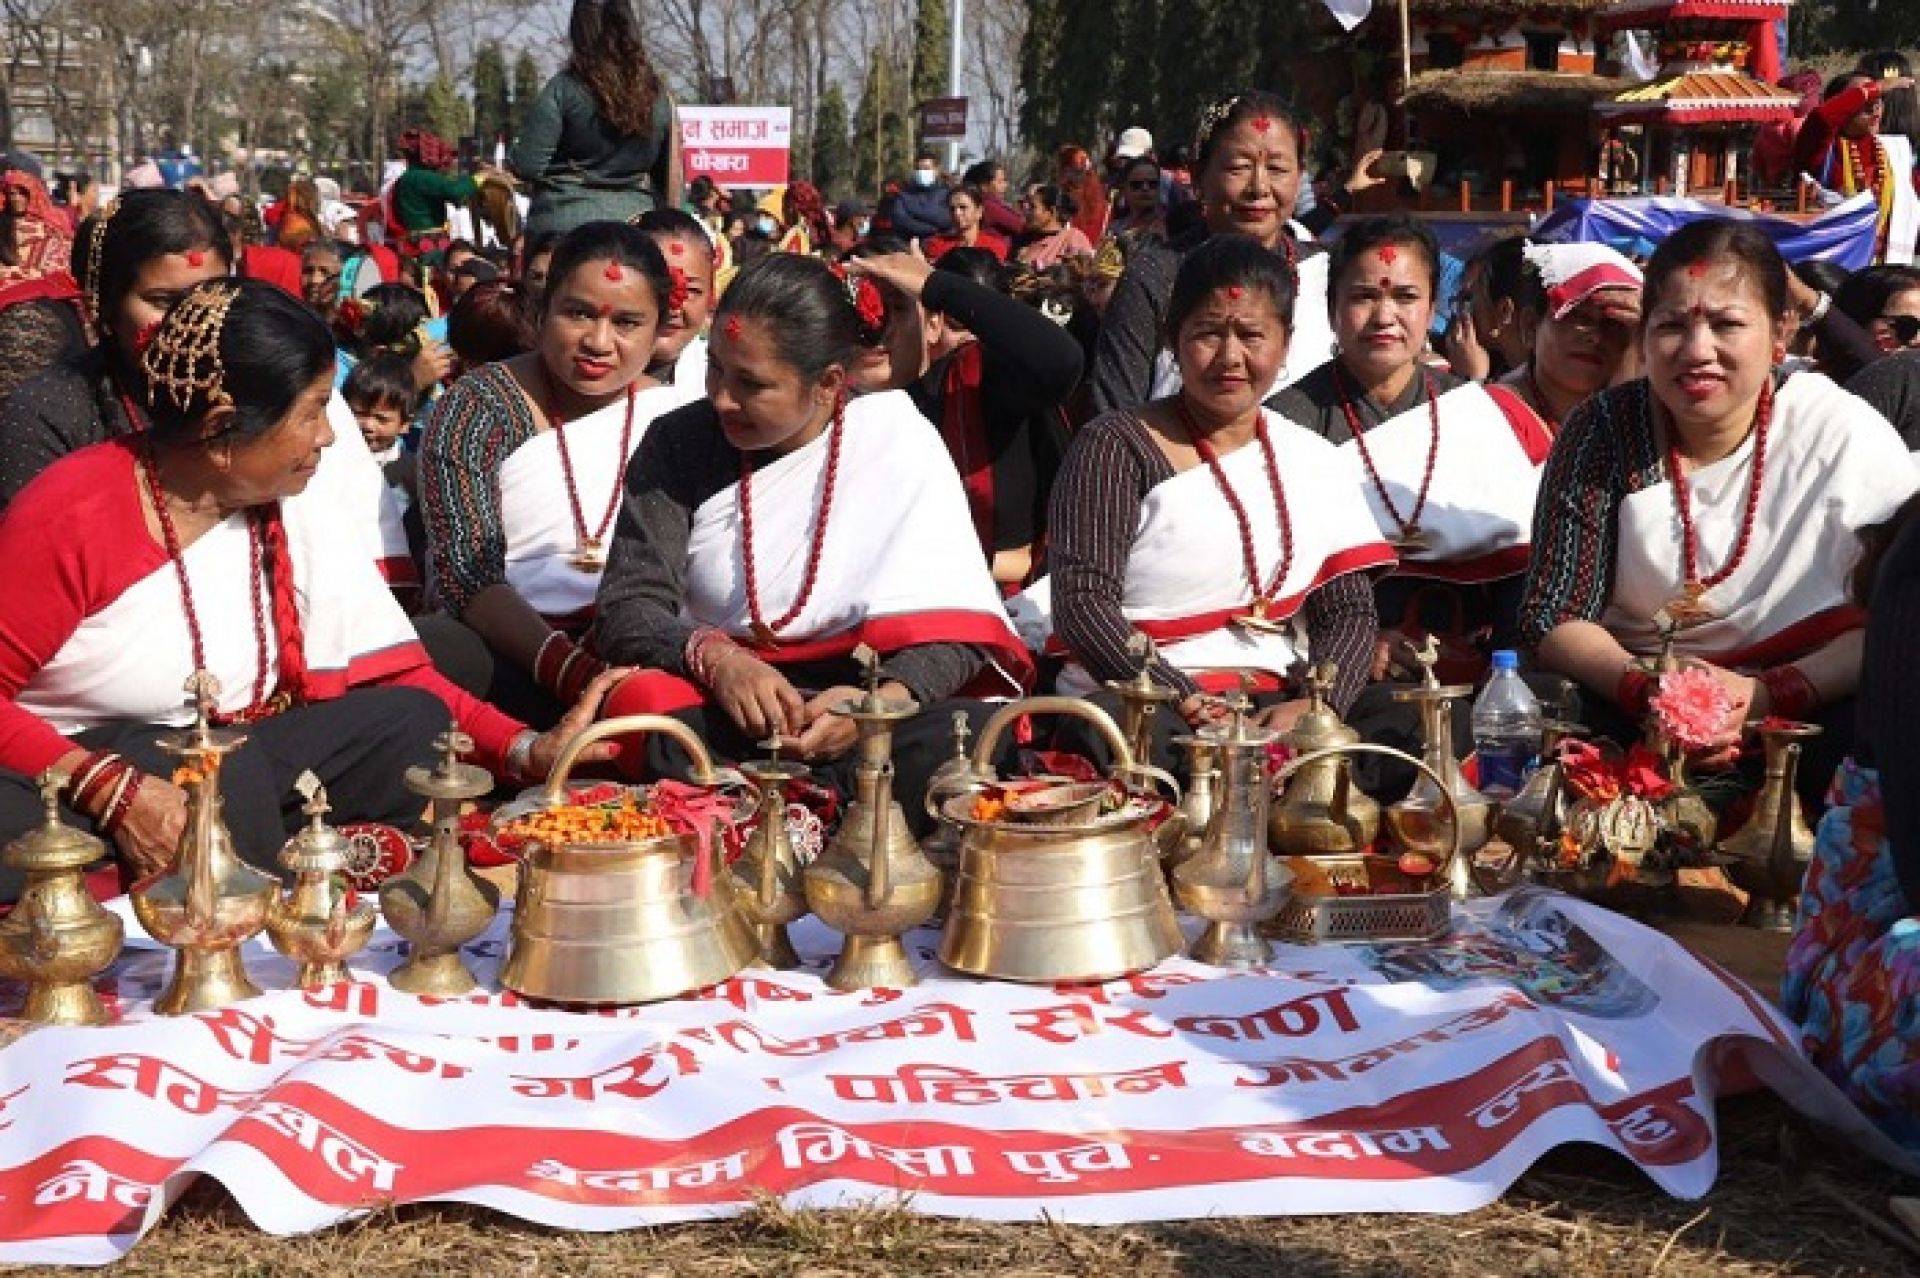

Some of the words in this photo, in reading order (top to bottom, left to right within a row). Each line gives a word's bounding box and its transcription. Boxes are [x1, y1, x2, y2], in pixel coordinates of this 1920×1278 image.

[709, 119, 768, 141] समाज
[690, 149, 750, 173] पोखरा
[826, 1062, 1188, 1105] पहिचान
[775, 1122, 976, 1178] मिसा
